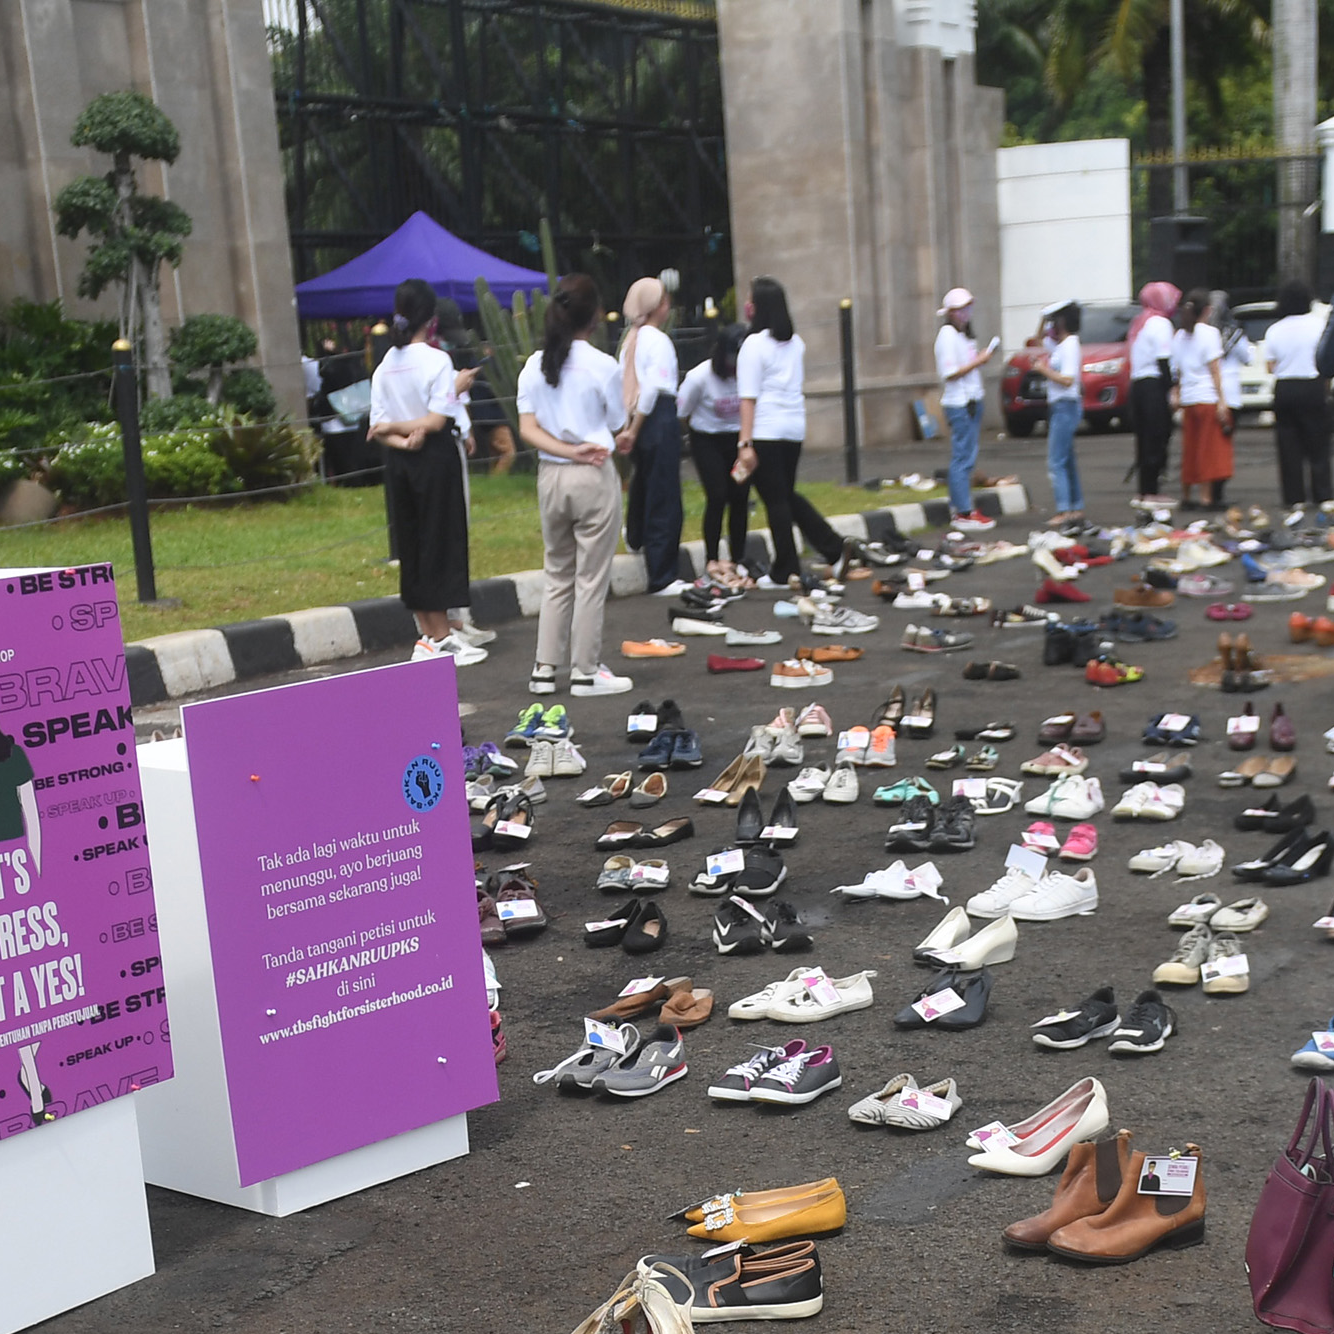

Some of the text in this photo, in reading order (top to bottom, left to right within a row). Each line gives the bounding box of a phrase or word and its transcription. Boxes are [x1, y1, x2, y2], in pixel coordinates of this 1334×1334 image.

[58, 566, 115, 589] STR
[34, 761, 125, 791] BE STRONG
[82, 836, 140, 862] SPEAK
[257, 818, 421, 872] Tak ada lagi waktu untuk
[260, 845, 423, 897] menunggu, ayo berjuang
[266, 865, 422, 920] bersama sekarang juga!
[111, 918, 145, 943] BE
[261, 908, 436, 970] Tanda tangani petisi untuk
[285, 936, 420, 988] #SAHKANRUUPKS
[13, 971, 31, 1017] A
[30, 953, 86, 1009] YES!
[336, 973, 376, 998] di sini
[30, 1018, 53, 1036] TANPA
[259, 974, 454, 1045] www.tbsfightforsisterhood.co.id
[67, 1035, 134, 1066] SPEAK UP
